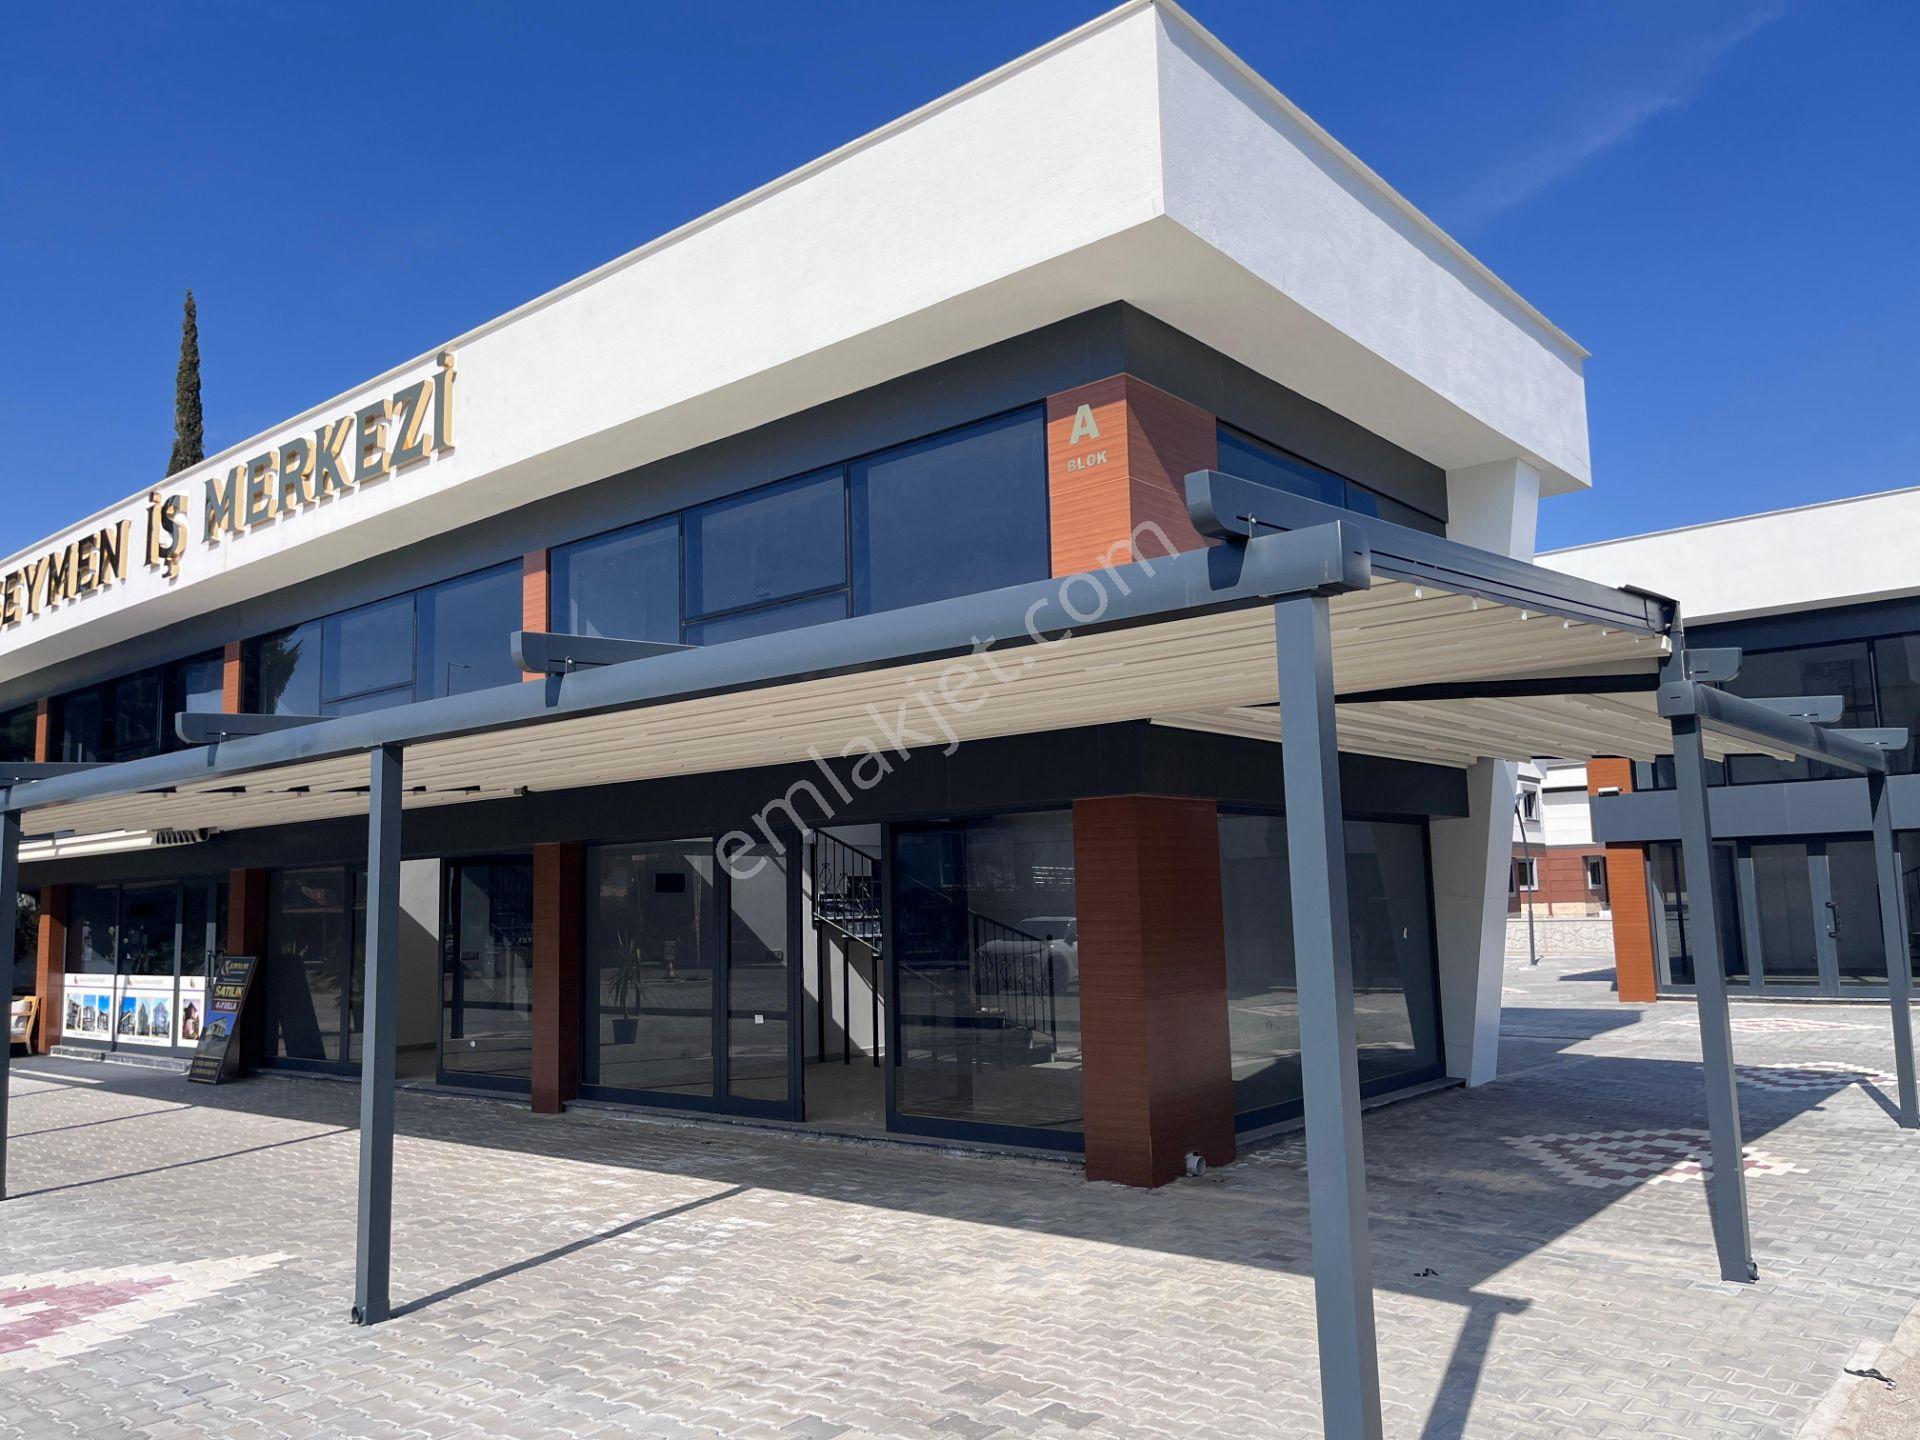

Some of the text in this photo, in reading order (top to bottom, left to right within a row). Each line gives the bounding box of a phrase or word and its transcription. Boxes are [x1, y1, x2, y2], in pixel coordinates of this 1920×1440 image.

[1069, 403, 1100, 445] A
[1067, 450, 1108, 472] BLOK
[0, 352, 456, 626] EYMEN İŞ MERKEZİ
[214, 986, 243, 998] SATILIK
